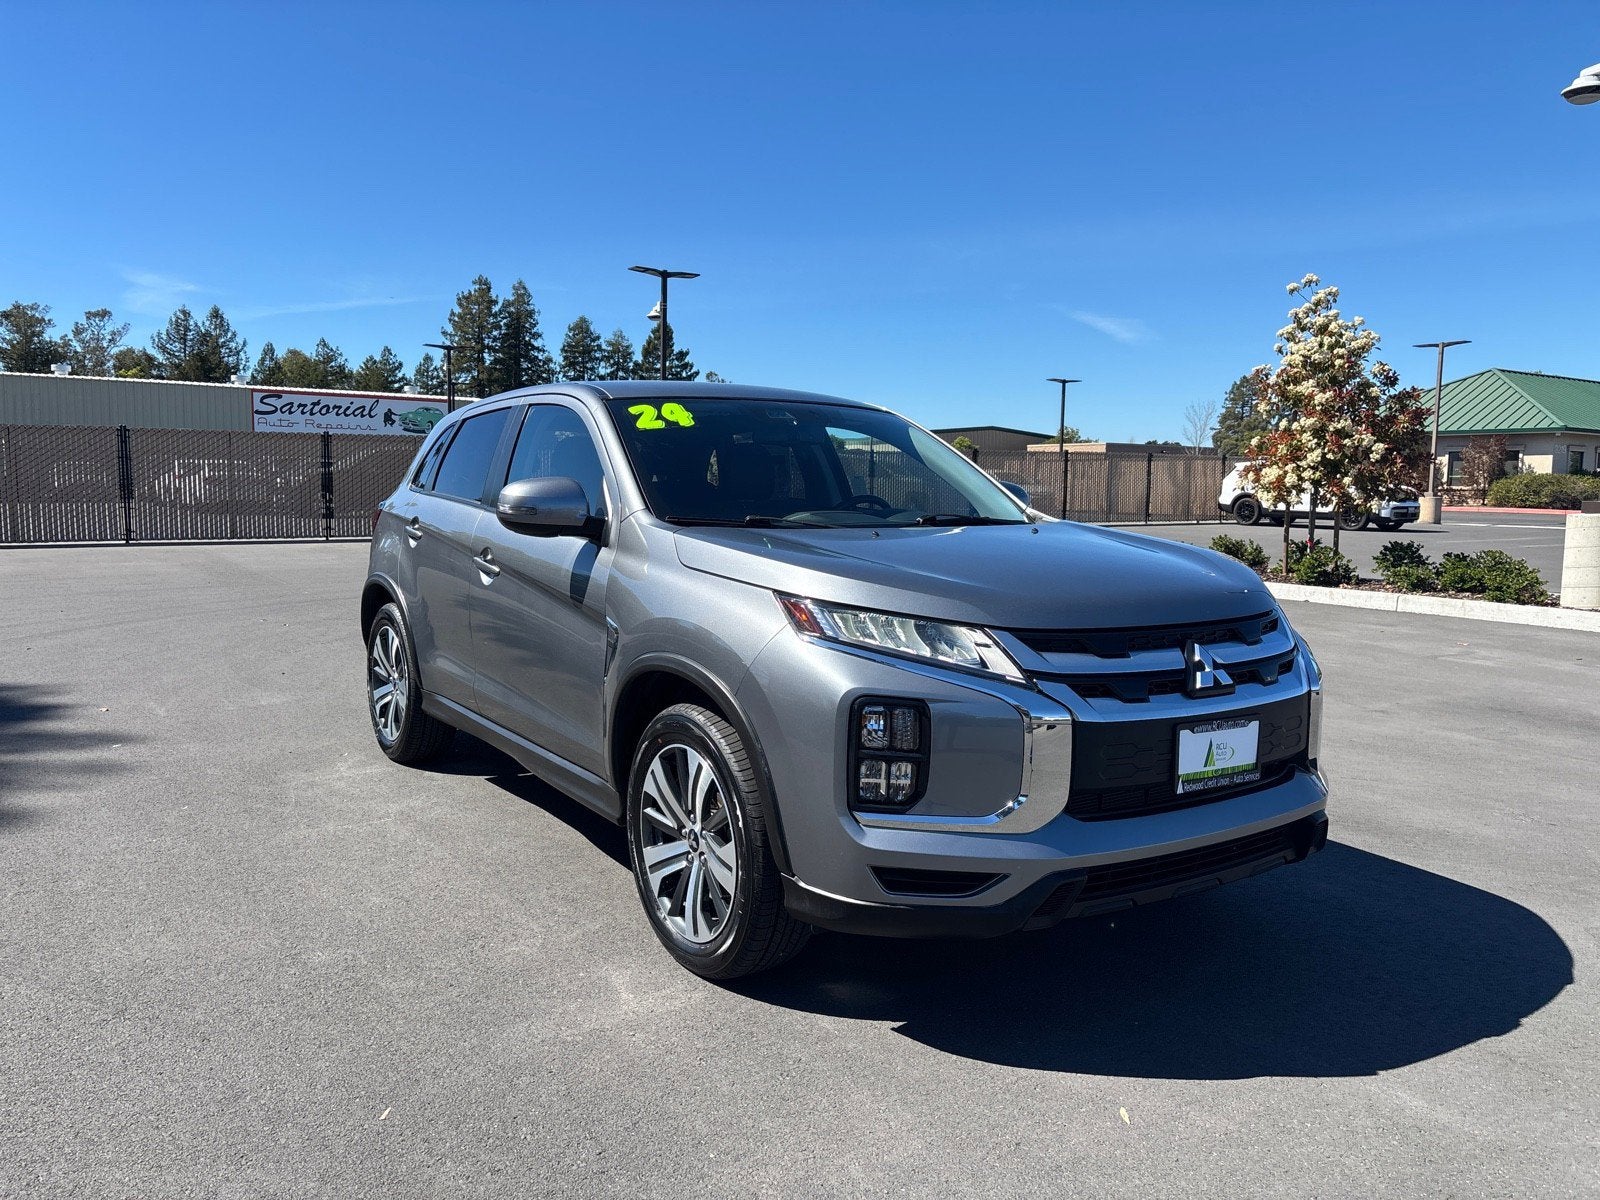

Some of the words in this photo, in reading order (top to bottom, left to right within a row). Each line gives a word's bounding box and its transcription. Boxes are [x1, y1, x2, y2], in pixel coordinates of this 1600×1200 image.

[254, 394, 379, 418] Sartorial
[628, 403, 695, 429] 24
[257, 417, 299, 428] Auto
[304, 418, 377, 431] Repairs
[1215, 741, 1228, 750] RCU
[1184, 781, 1204, 792] Redwood
[1204, 778, 1217, 789] Credit
[1217, 777, 1229, 787] Union
[1243, 772, 1260, 782] Services
